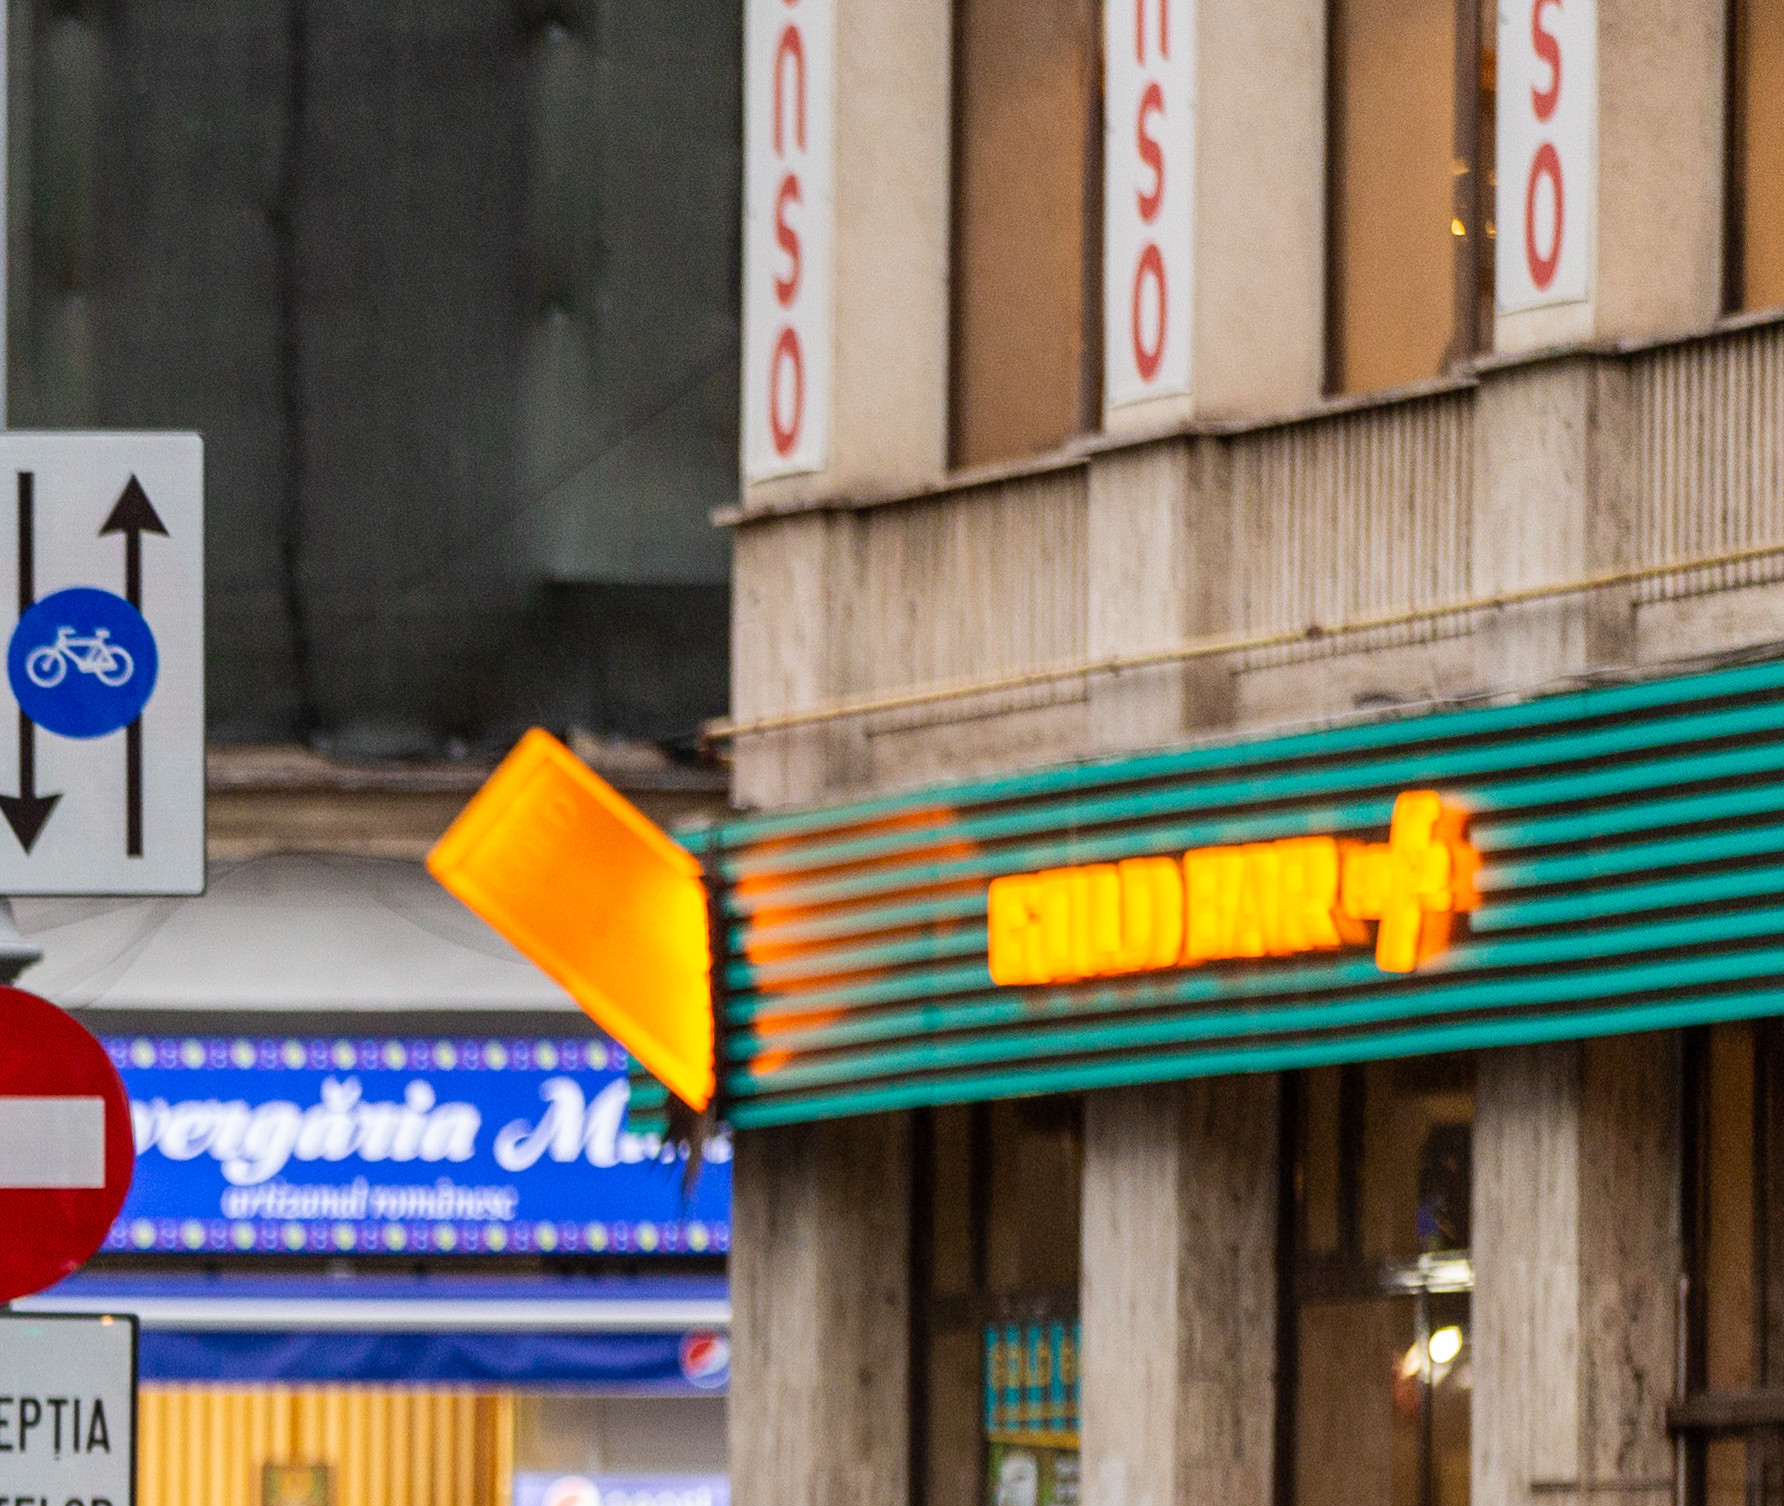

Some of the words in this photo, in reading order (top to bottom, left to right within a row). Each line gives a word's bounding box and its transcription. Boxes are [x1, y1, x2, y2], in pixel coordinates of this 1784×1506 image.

[770, 0, 807, 461] nso
[1183, 836, 1339, 966] BAR
[134, 1076, 482, 1186] vergăria
